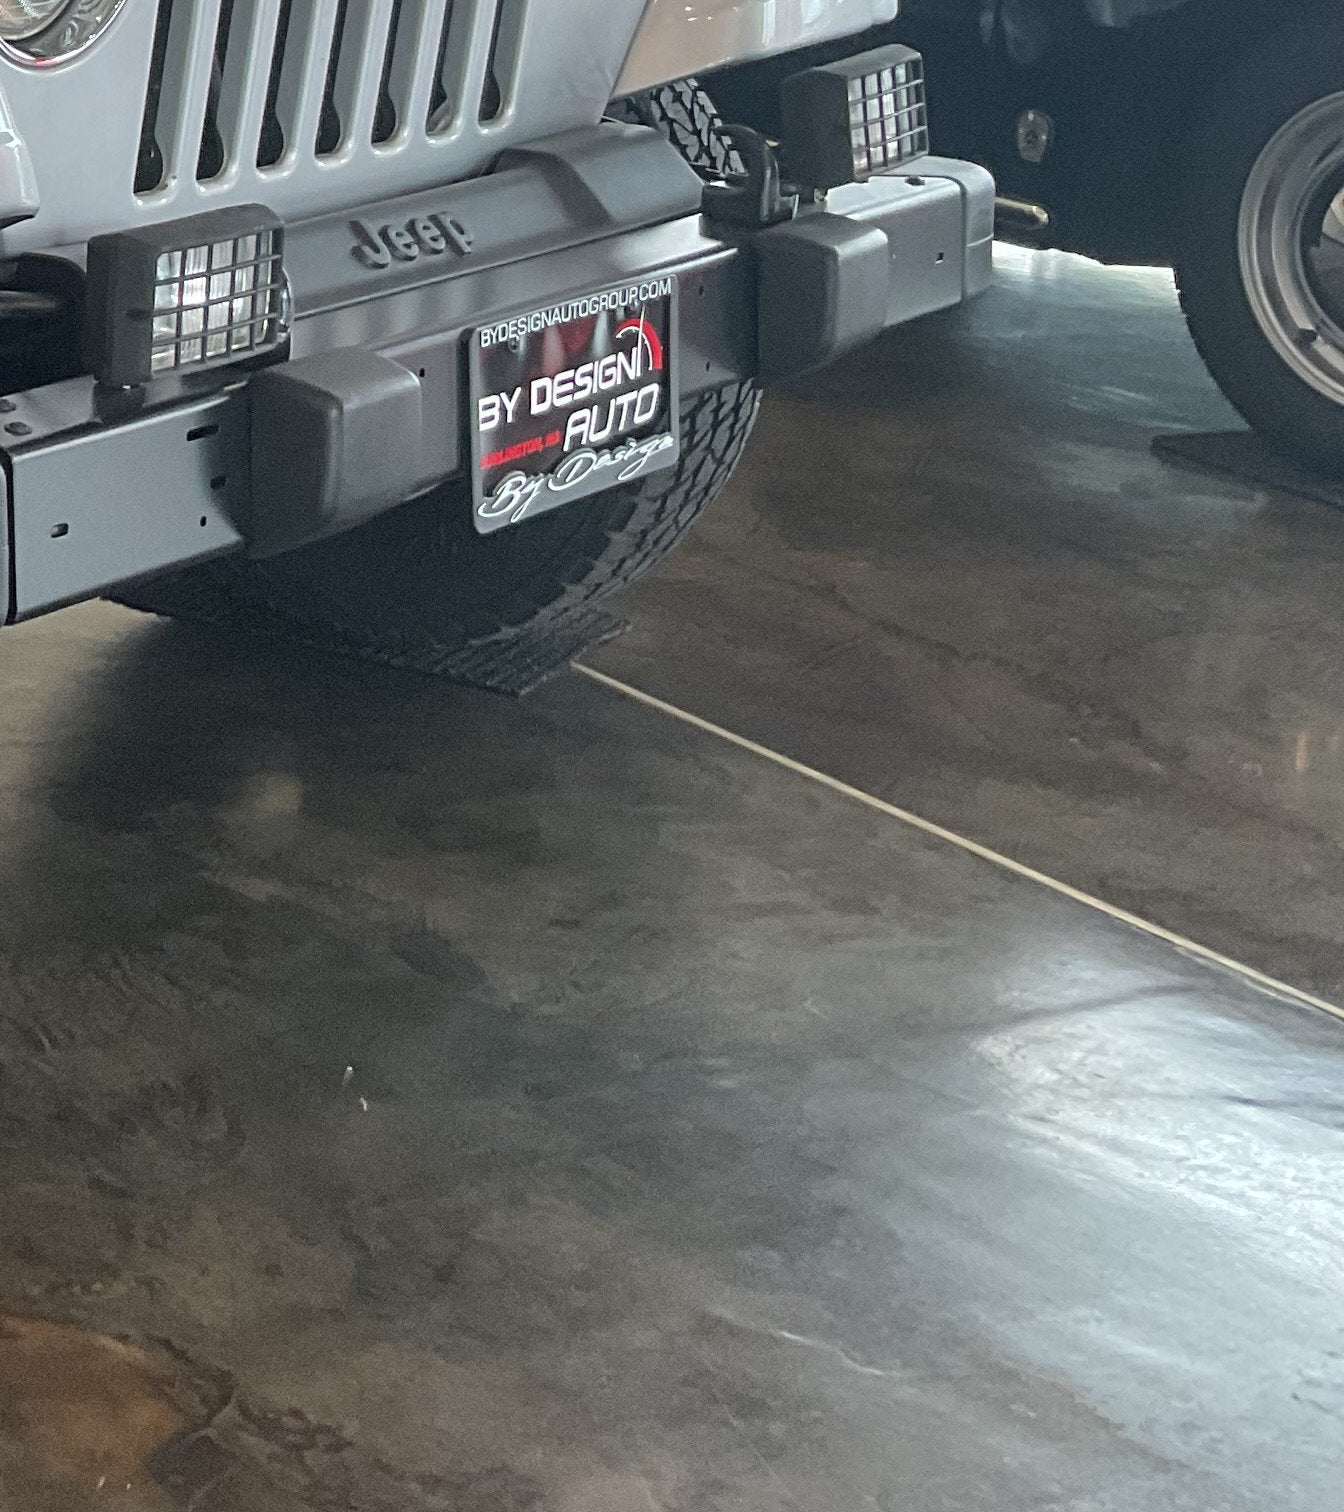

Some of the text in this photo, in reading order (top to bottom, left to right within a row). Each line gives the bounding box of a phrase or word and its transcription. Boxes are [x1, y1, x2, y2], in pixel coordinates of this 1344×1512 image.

[349, 211, 473, 269] Jeep
[479, 278, 672, 348] BYDESIGNAUTOGROUP.COM
[478, 346, 642, 432] BY DESIGN
[563, 383, 660, 452] AUTO
[477, 435, 674, 523] By Design
